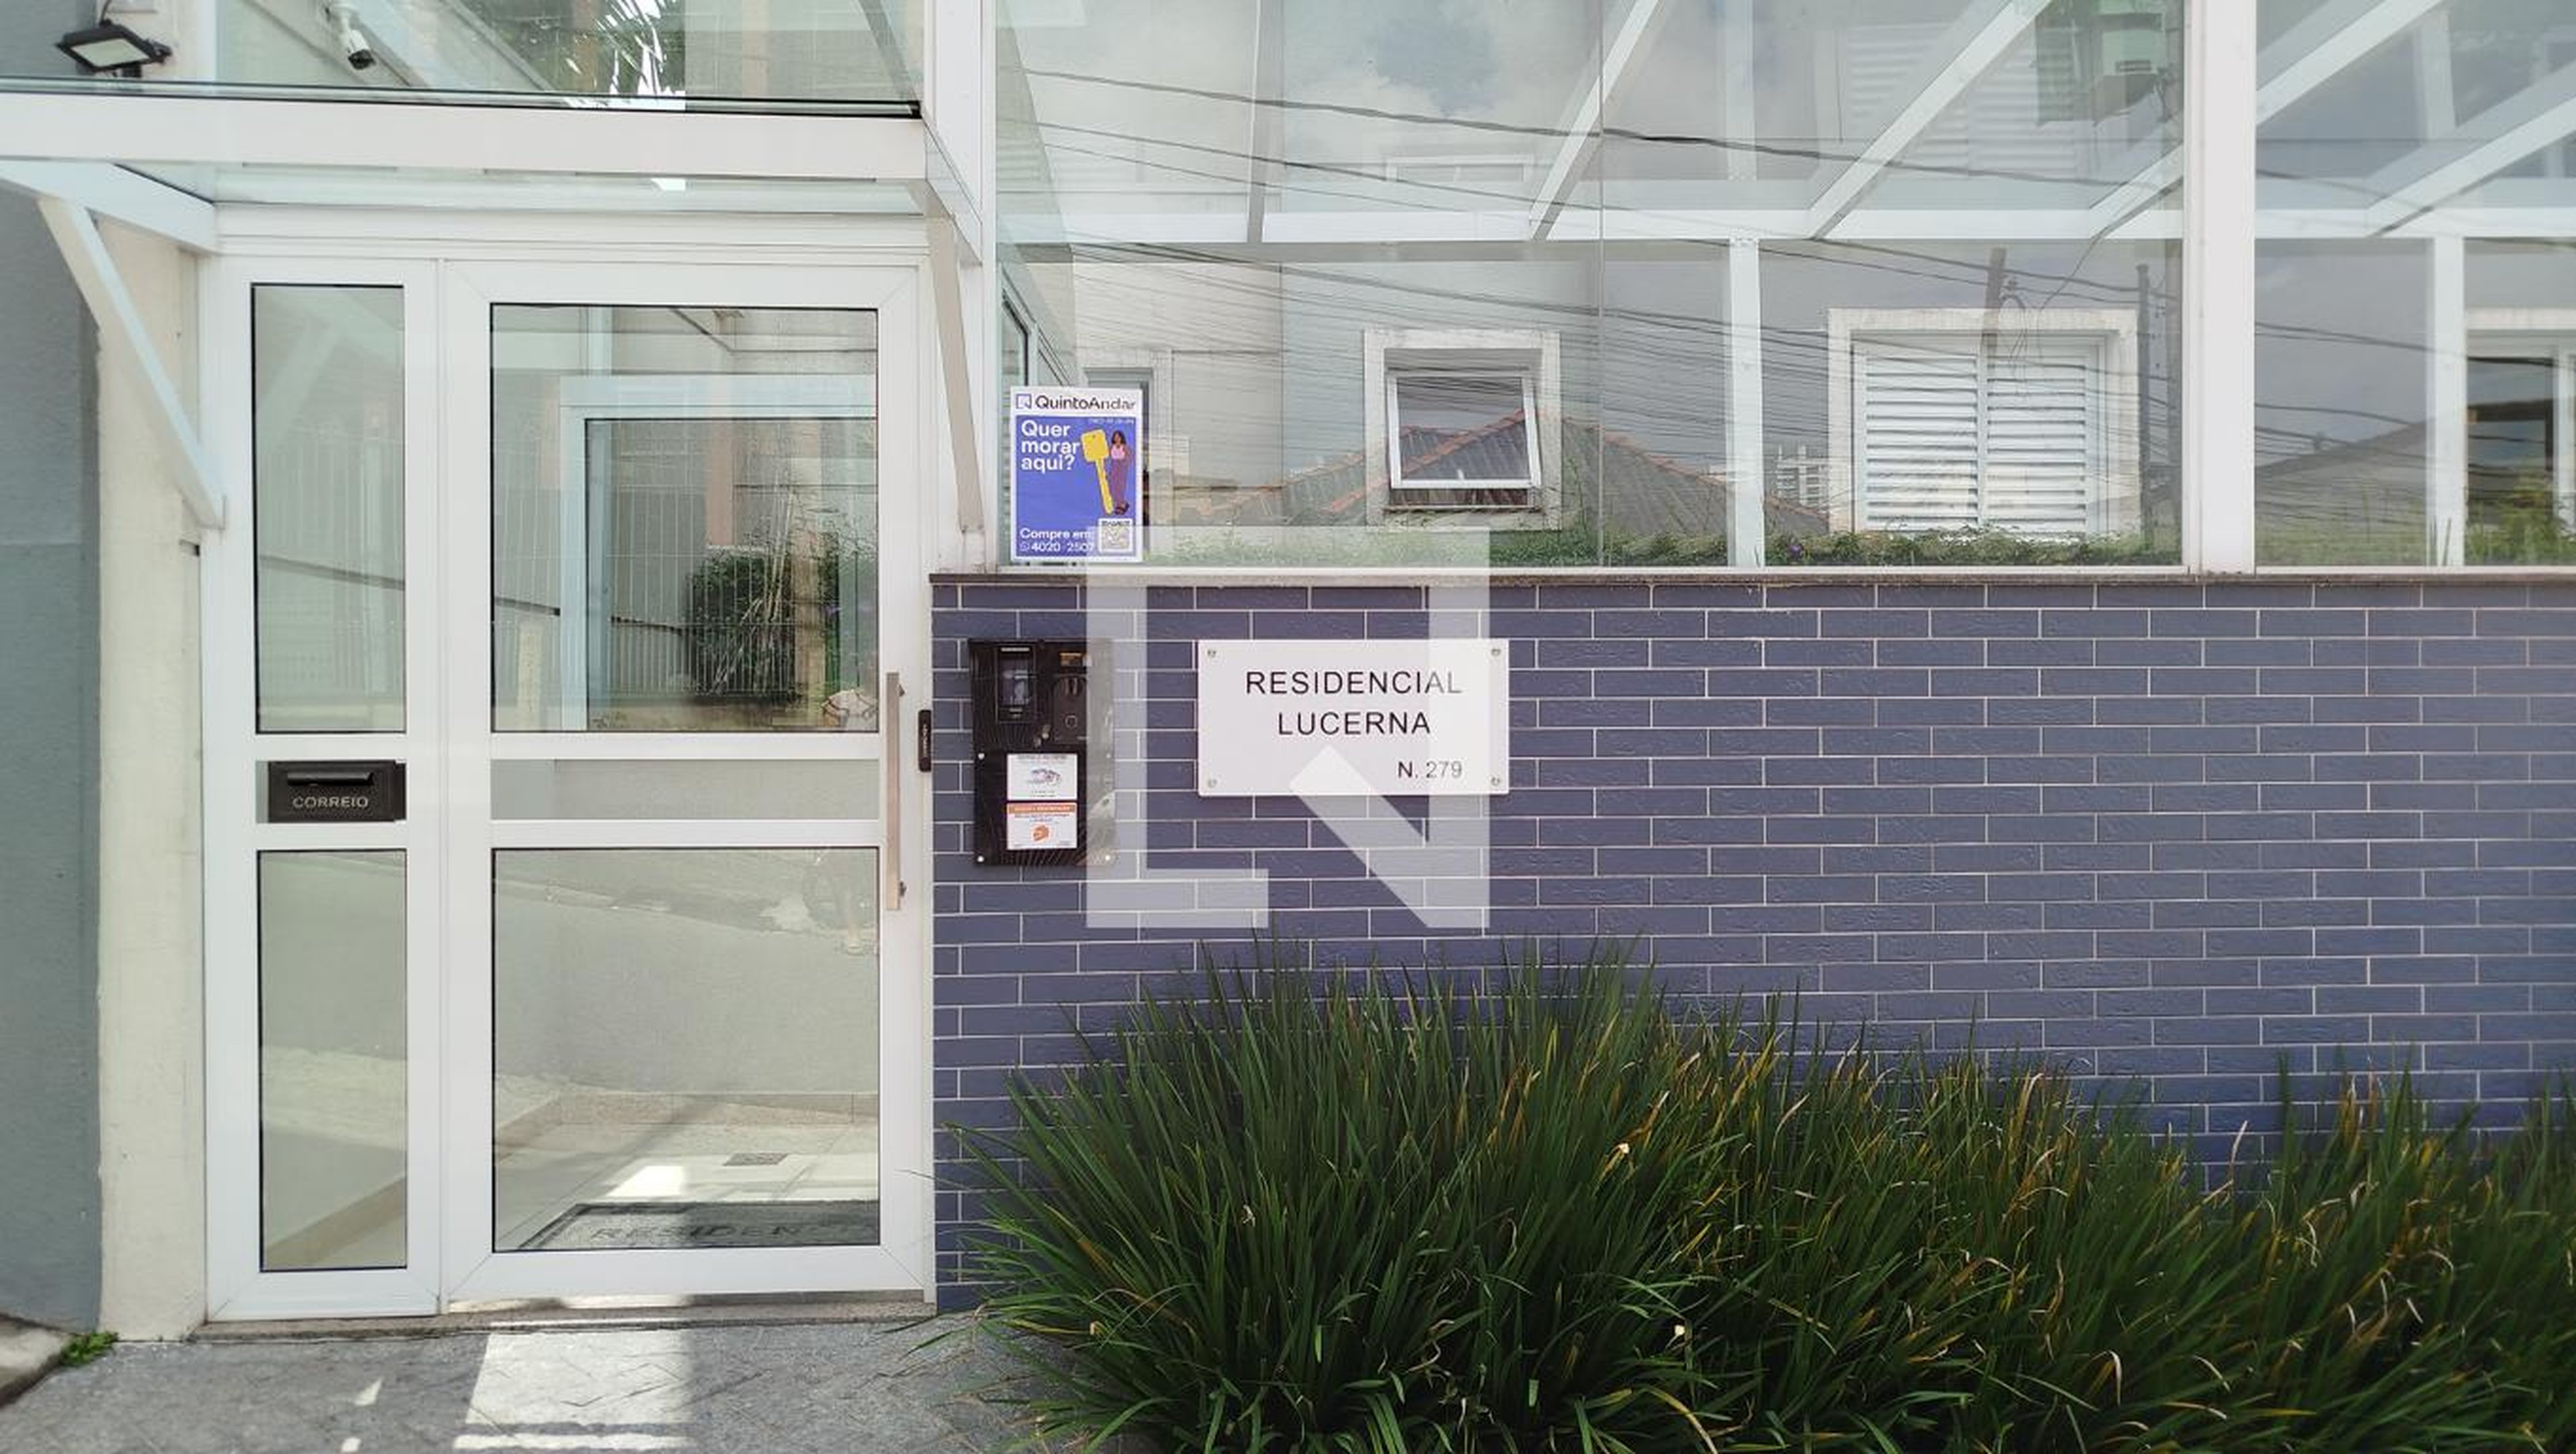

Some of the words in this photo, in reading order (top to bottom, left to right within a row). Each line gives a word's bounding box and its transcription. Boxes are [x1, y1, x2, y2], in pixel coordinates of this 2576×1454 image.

[1035, 395, 1136, 410] QuintoAndar
[1021, 419, 1071, 437] Quer
[1021, 440, 1080, 454] morar
[1021, 454, 1075, 474] aqui?
[1020, 527, 1070, 540] Compre
[1246, 671, 1462, 694] RESIDENCIAL
[1279, 711, 1431, 735] LUCERNA
[1397, 761, 1419, 779] N.
[1426, 761, 1462, 779] 279
[292, 796, 369, 809] CORREIO
